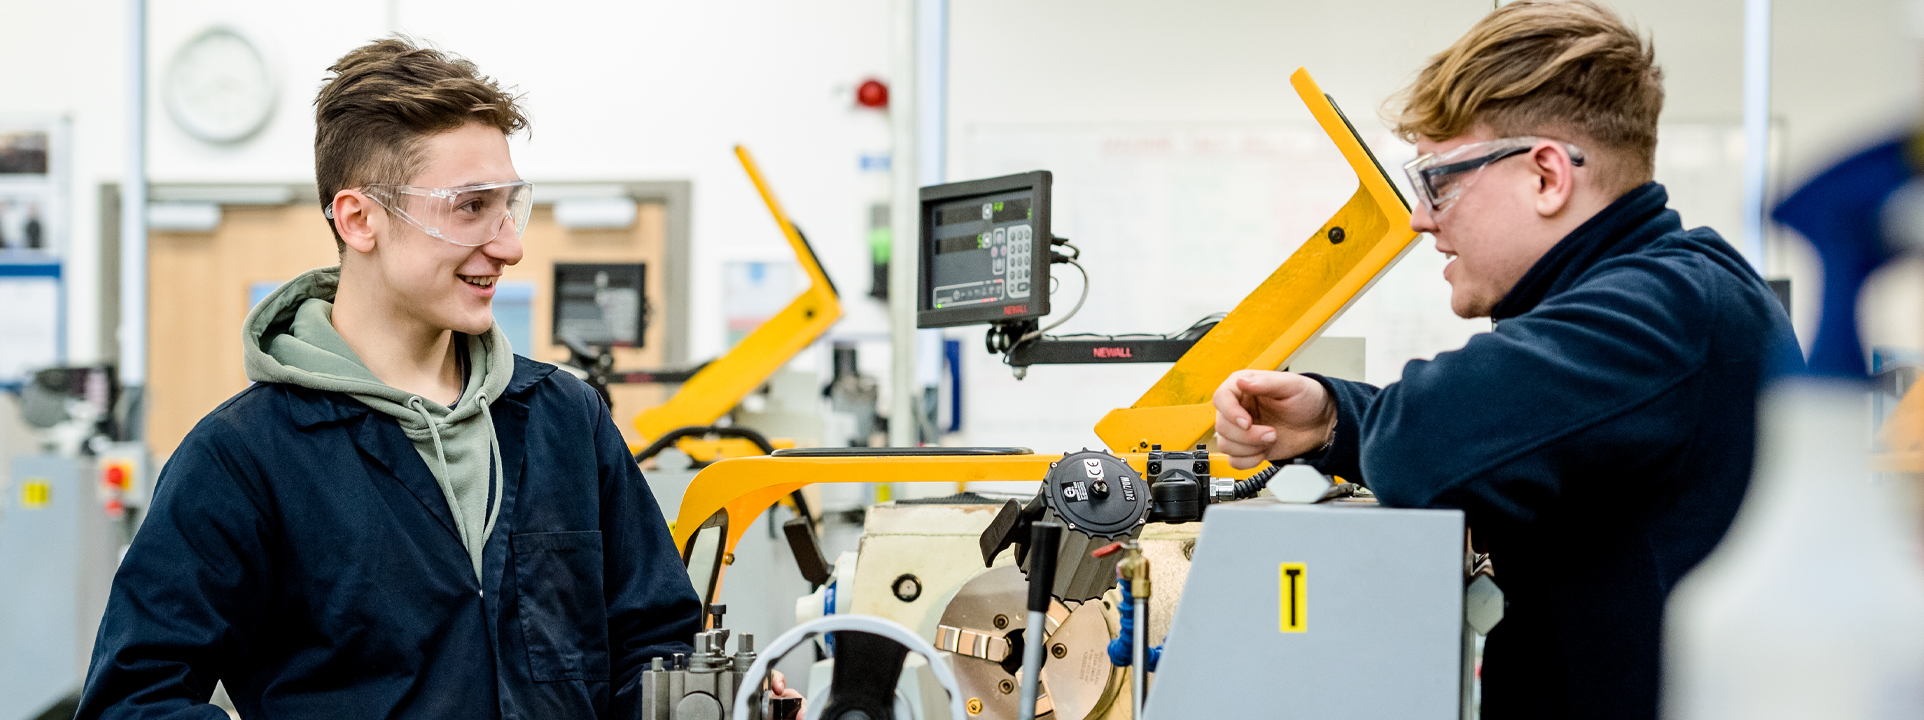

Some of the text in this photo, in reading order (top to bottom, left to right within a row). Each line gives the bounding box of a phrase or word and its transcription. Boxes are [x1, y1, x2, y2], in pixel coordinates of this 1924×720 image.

[1003, 305, 1028, 315] NEWALL
[1093, 347, 1132, 358] NEWALL
[1119, 476, 1135, 501] 24V/70W
[1286, 569, 1301, 626] T
